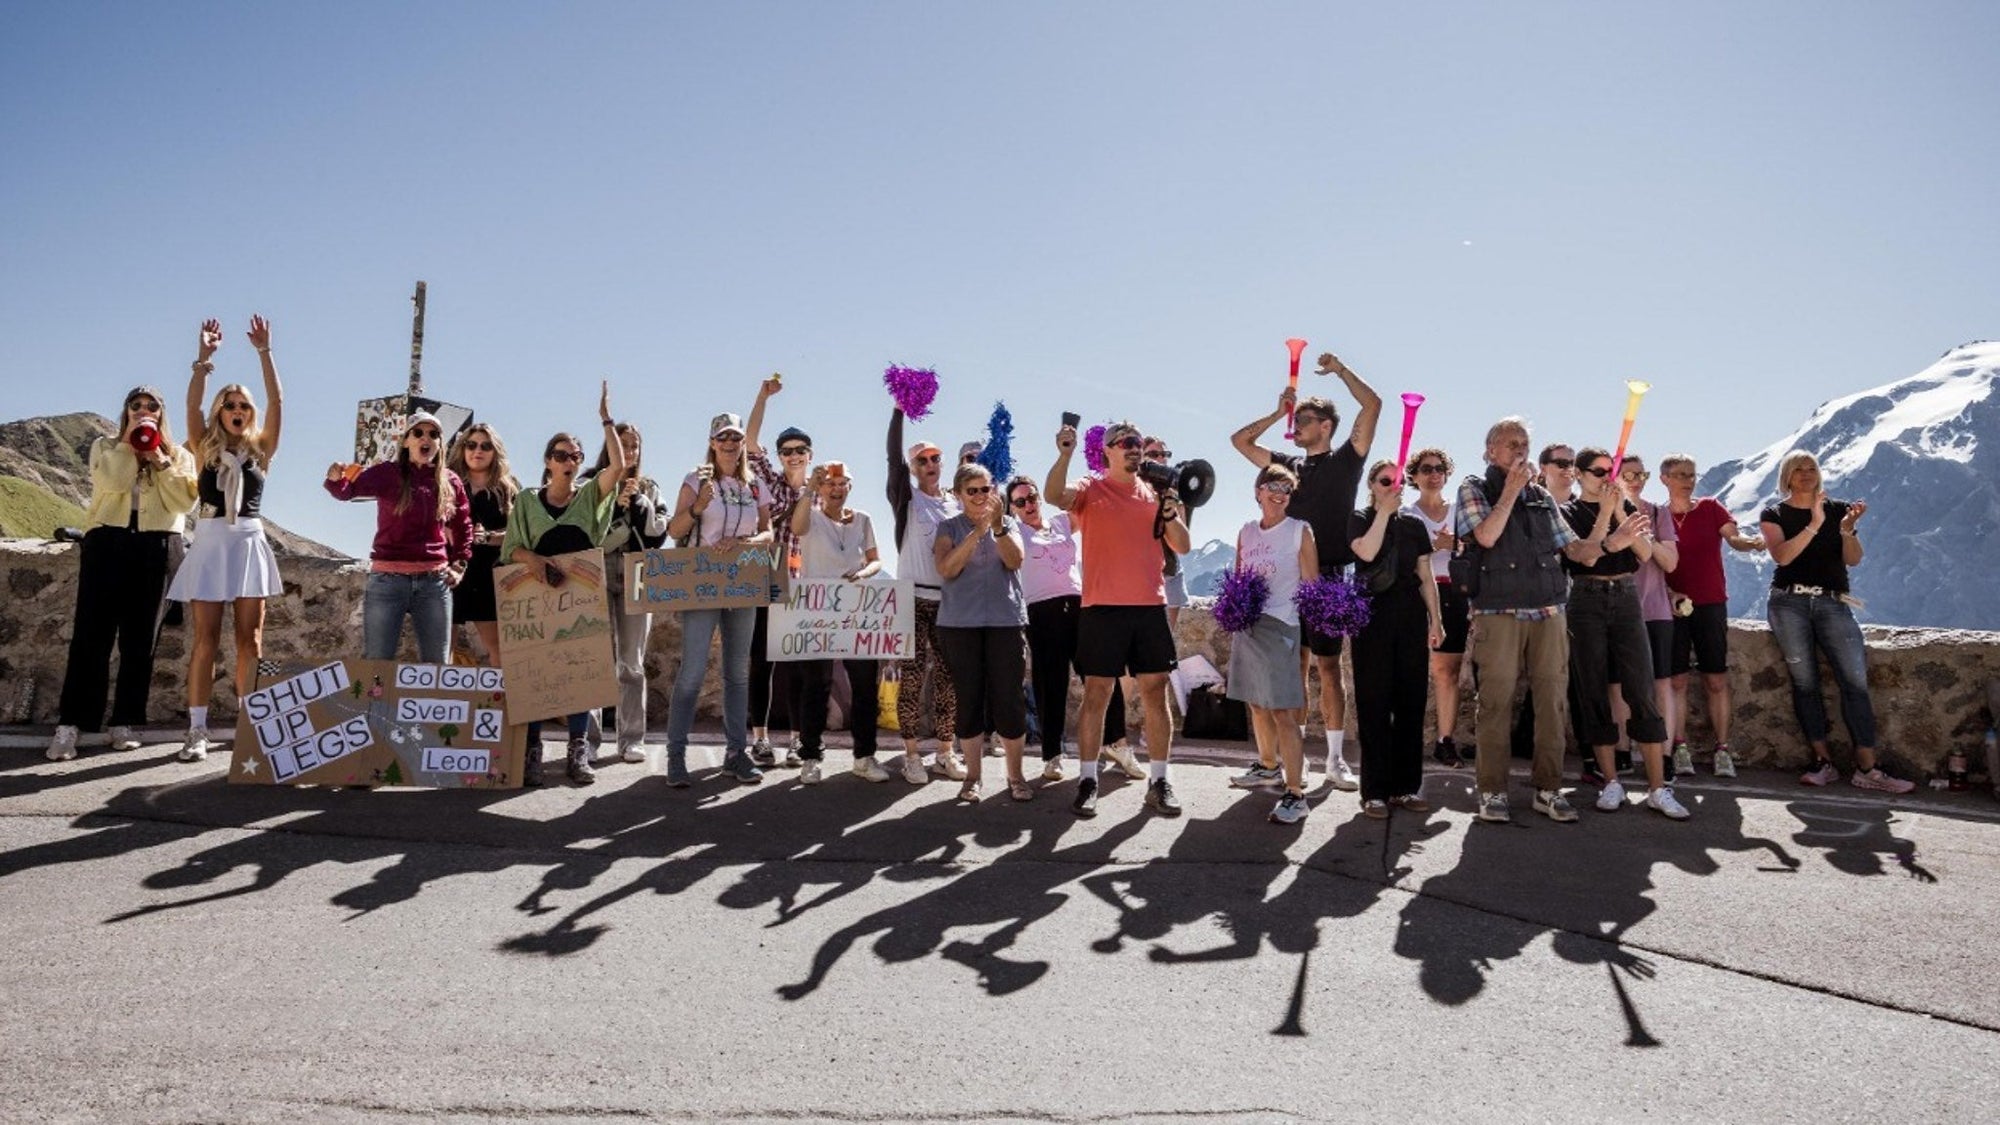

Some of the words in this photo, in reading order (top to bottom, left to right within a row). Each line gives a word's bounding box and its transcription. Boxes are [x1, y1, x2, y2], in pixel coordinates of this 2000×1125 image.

[796, 616, 839, 630] was
[248, 662, 343, 721] SHUT
[258, 711, 308, 749] UP
[401, 699, 462, 721] Sven
[475, 711, 498, 739] &
[270, 719, 371, 781] LEGS
[425, 750, 488, 771] Leon
